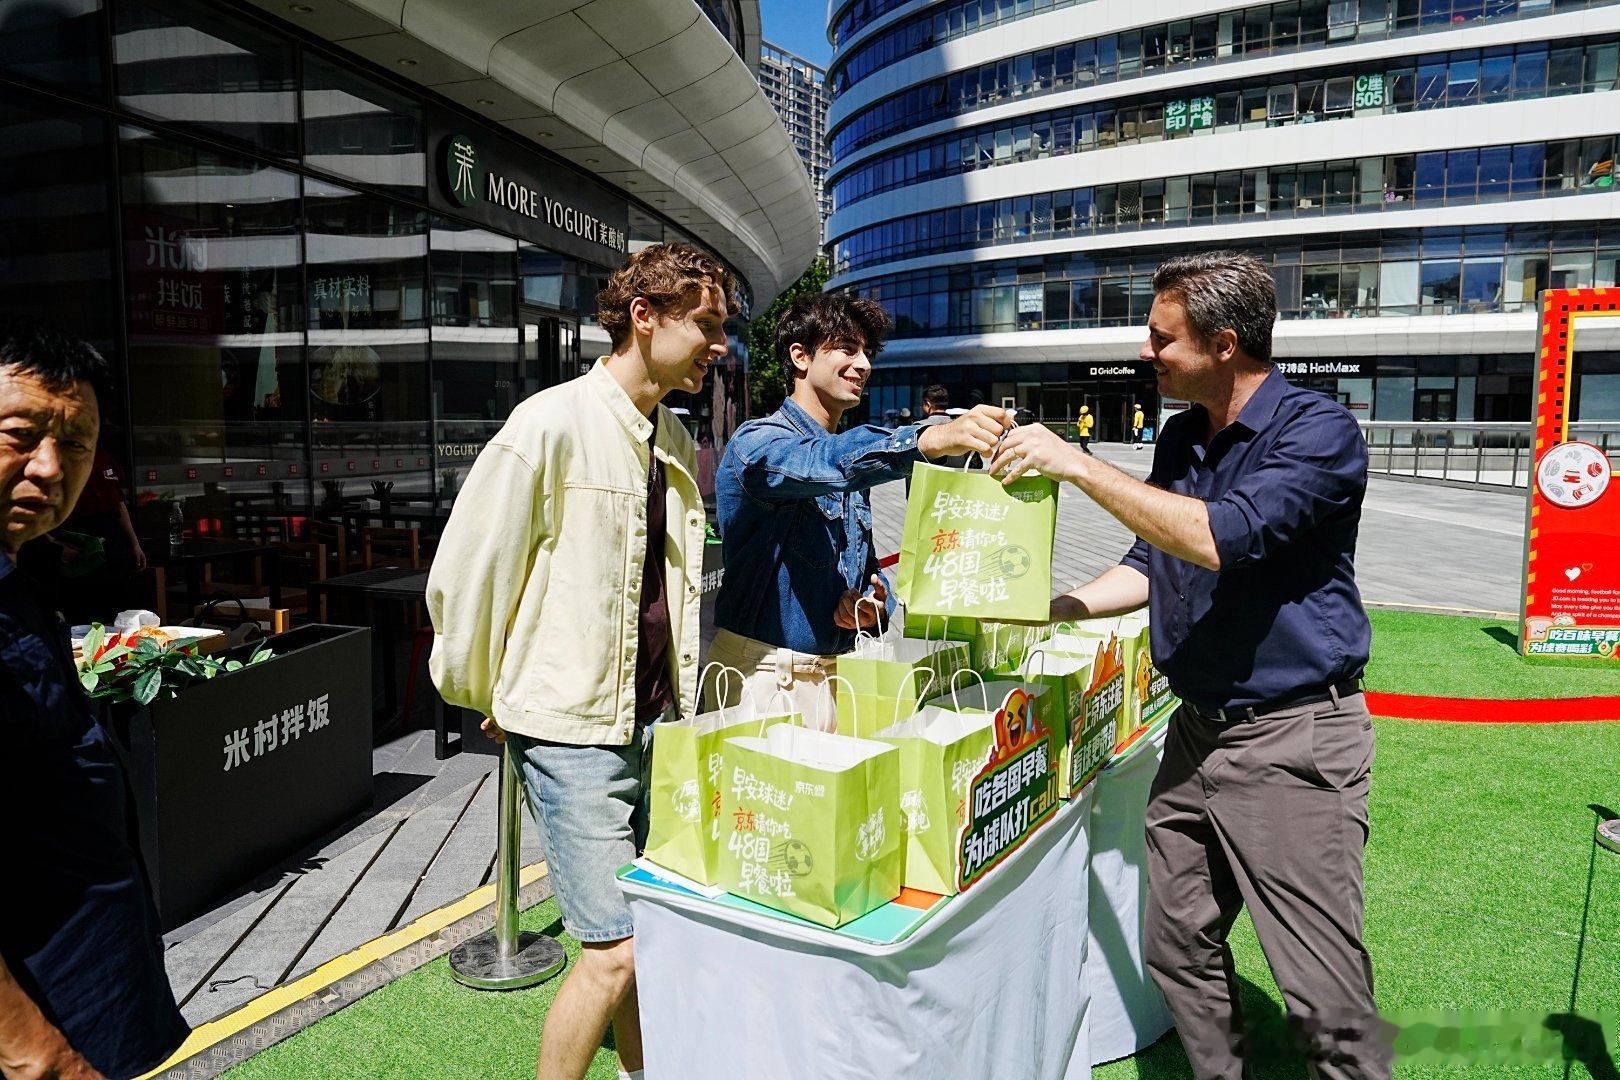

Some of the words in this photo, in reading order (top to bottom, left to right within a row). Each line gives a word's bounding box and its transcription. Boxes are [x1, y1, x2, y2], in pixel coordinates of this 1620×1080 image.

[1356, 74, 1382, 92] C座
[1356, 90, 1382, 107] 505
[489, 172, 538, 218] MORE
[544, 196, 598, 243] YOGURT
[314, 274, 371, 301] 真材实料
[1098, 367, 1135, 375] GridCoffee
[438, 444, 479, 457] YOGURT
[923, 551, 981, 580] 48国
[936, 577, 1009, 609] 早餐啦
[224, 693, 329, 771] 米村拌饭
[731, 766, 794, 811] 早安球迷!
[728, 831, 771, 864] 48国
[739, 863, 796, 897] 早餐啦
